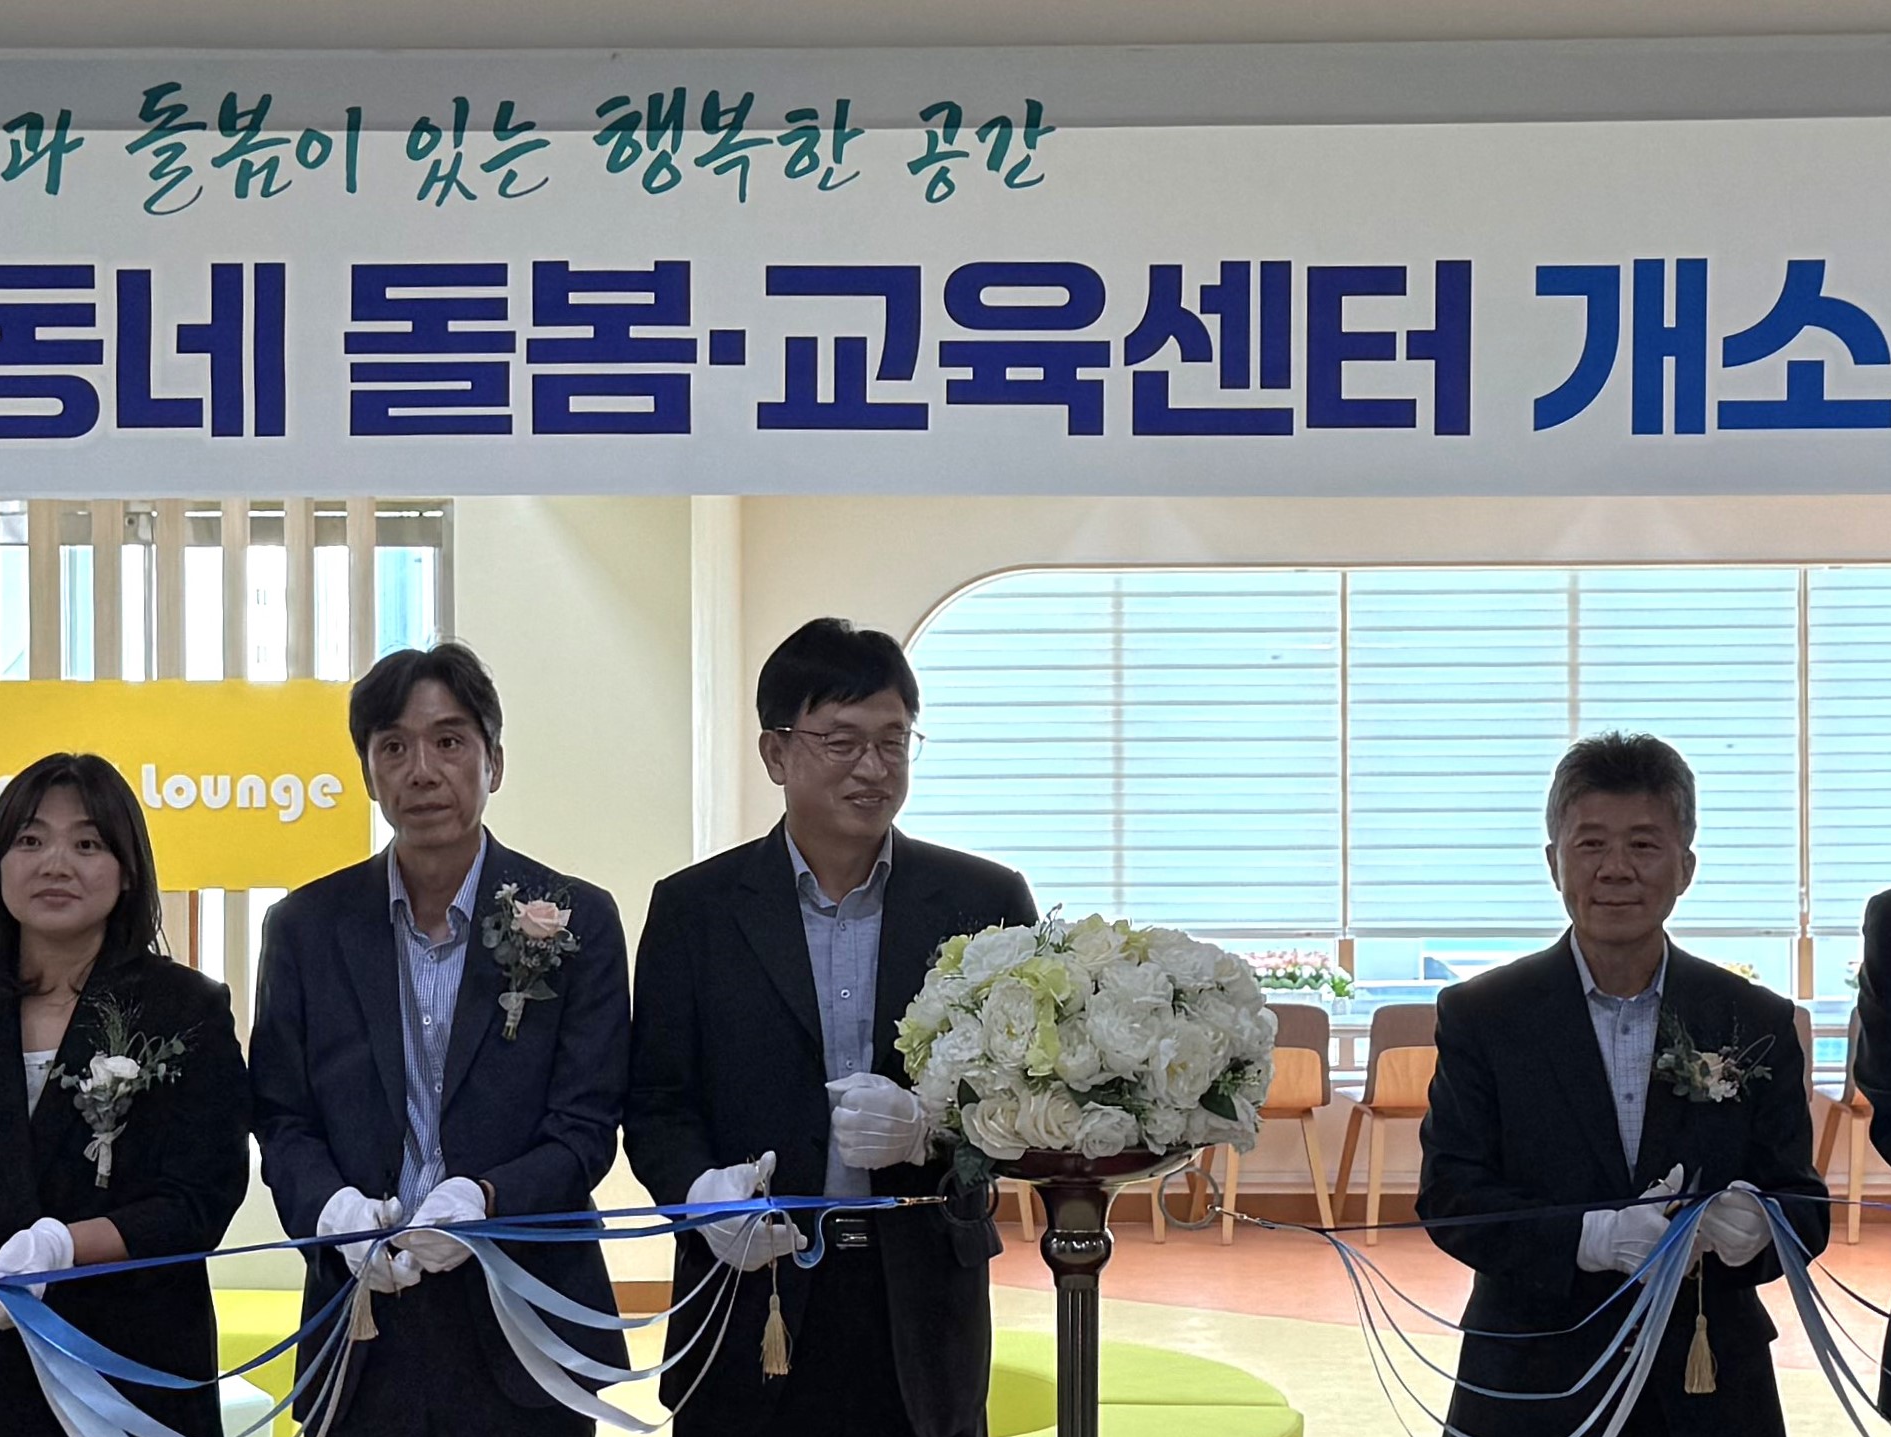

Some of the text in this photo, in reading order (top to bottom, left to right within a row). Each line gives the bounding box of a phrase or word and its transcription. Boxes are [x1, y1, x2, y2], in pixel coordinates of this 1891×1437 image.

[124, 82, 363, 215] 돌봄이
[405, 96, 551, 206] 있는
[593, 87, 866, 203] 행복한
[906, 97, 1057, 203] 공간
[343, 259, 1472, 438] 돌봄·교육센터
[140, 763, 343, 823] Lounge
